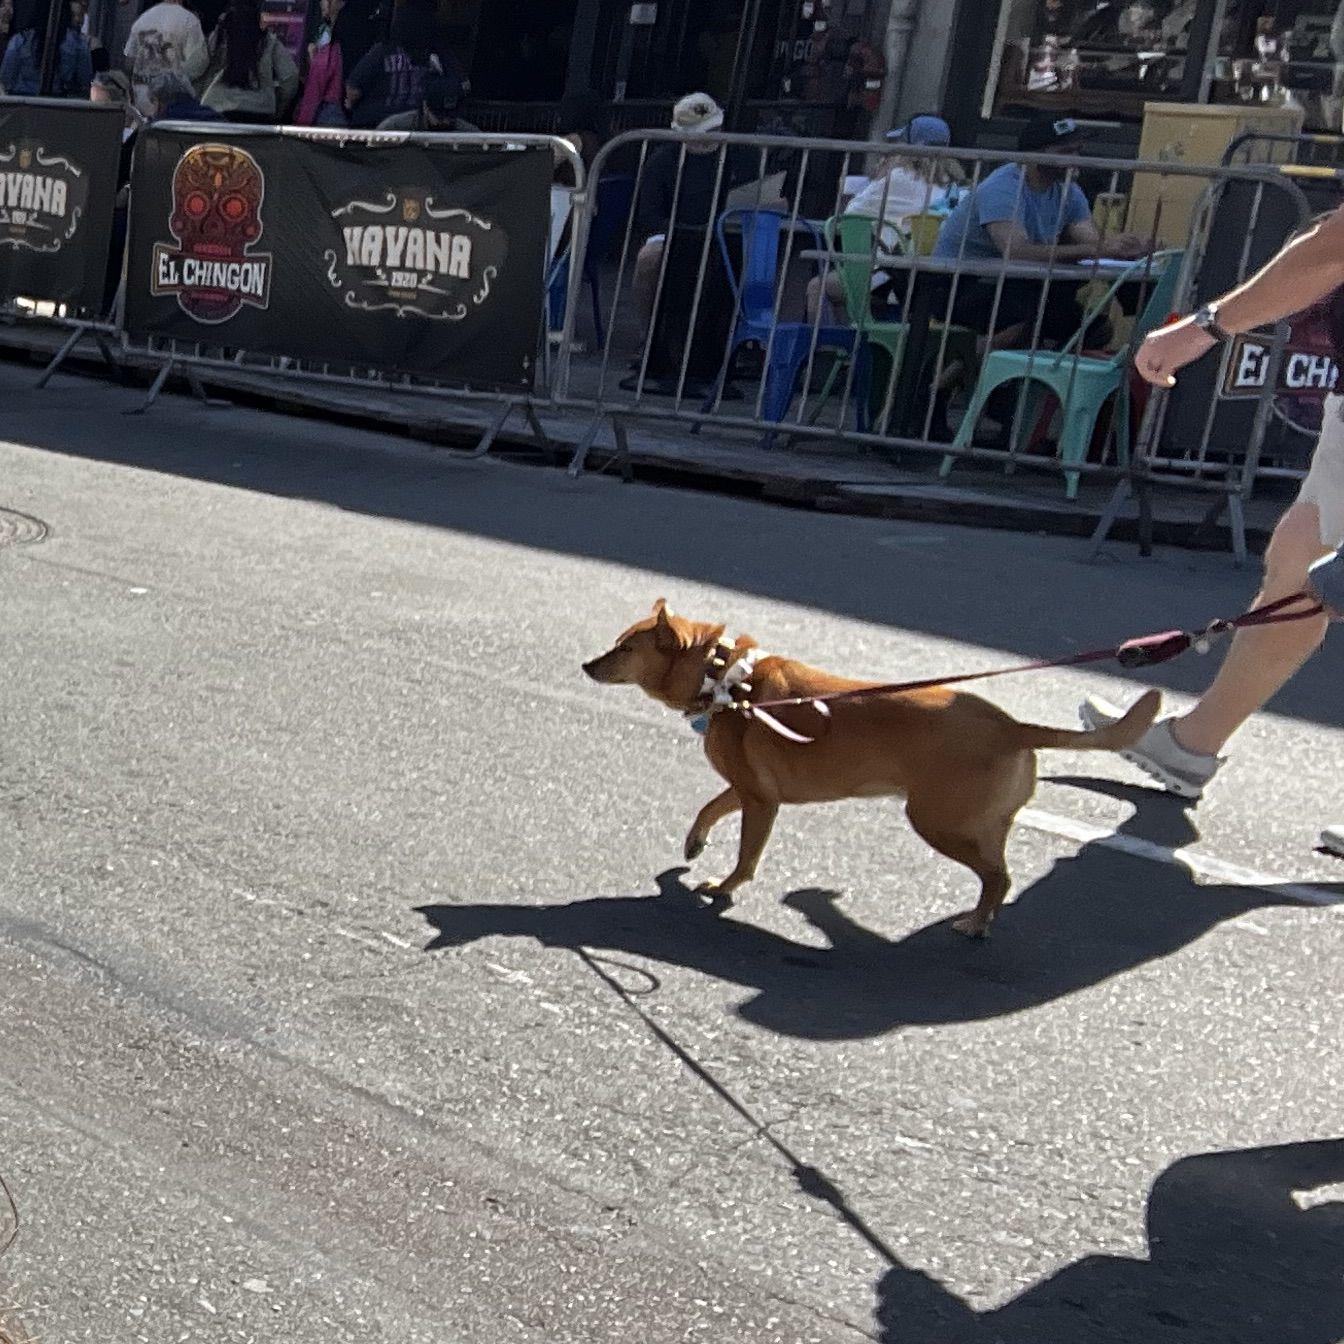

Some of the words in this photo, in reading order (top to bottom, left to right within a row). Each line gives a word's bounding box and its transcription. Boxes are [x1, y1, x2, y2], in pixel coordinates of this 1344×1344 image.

[158, 252, 180, 287] EL
[183, 258, 267, 297] CHINGON
[343, 226, 472, 279] HAVANA
